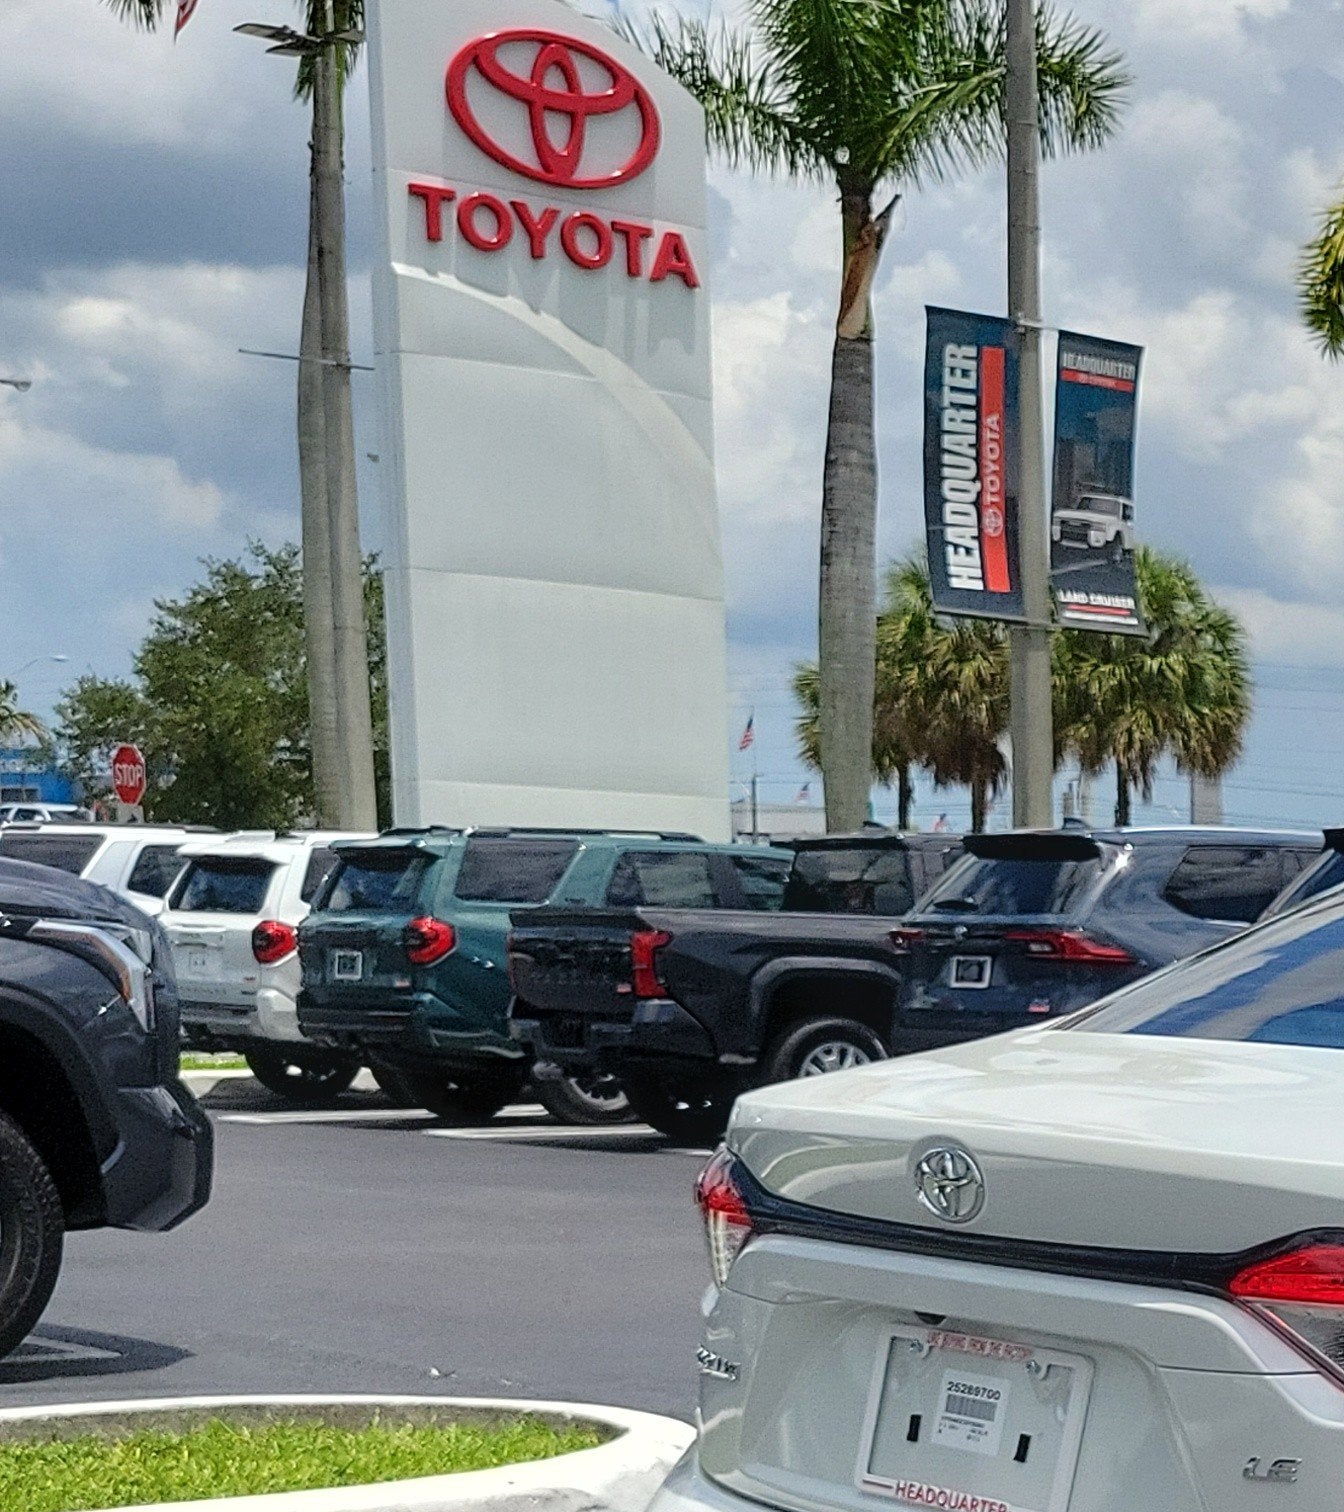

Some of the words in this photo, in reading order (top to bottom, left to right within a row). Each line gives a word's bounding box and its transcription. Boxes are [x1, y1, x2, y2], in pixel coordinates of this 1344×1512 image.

[408, 182, 699, 288] TOYOTA
[939, 343, 984, 591] HEADQUARTER
[981, 413, 1002, 505] TOYOTA
[115, 764, 141, 787] STOP
[1243, 1455, 1302, 1482] LE
